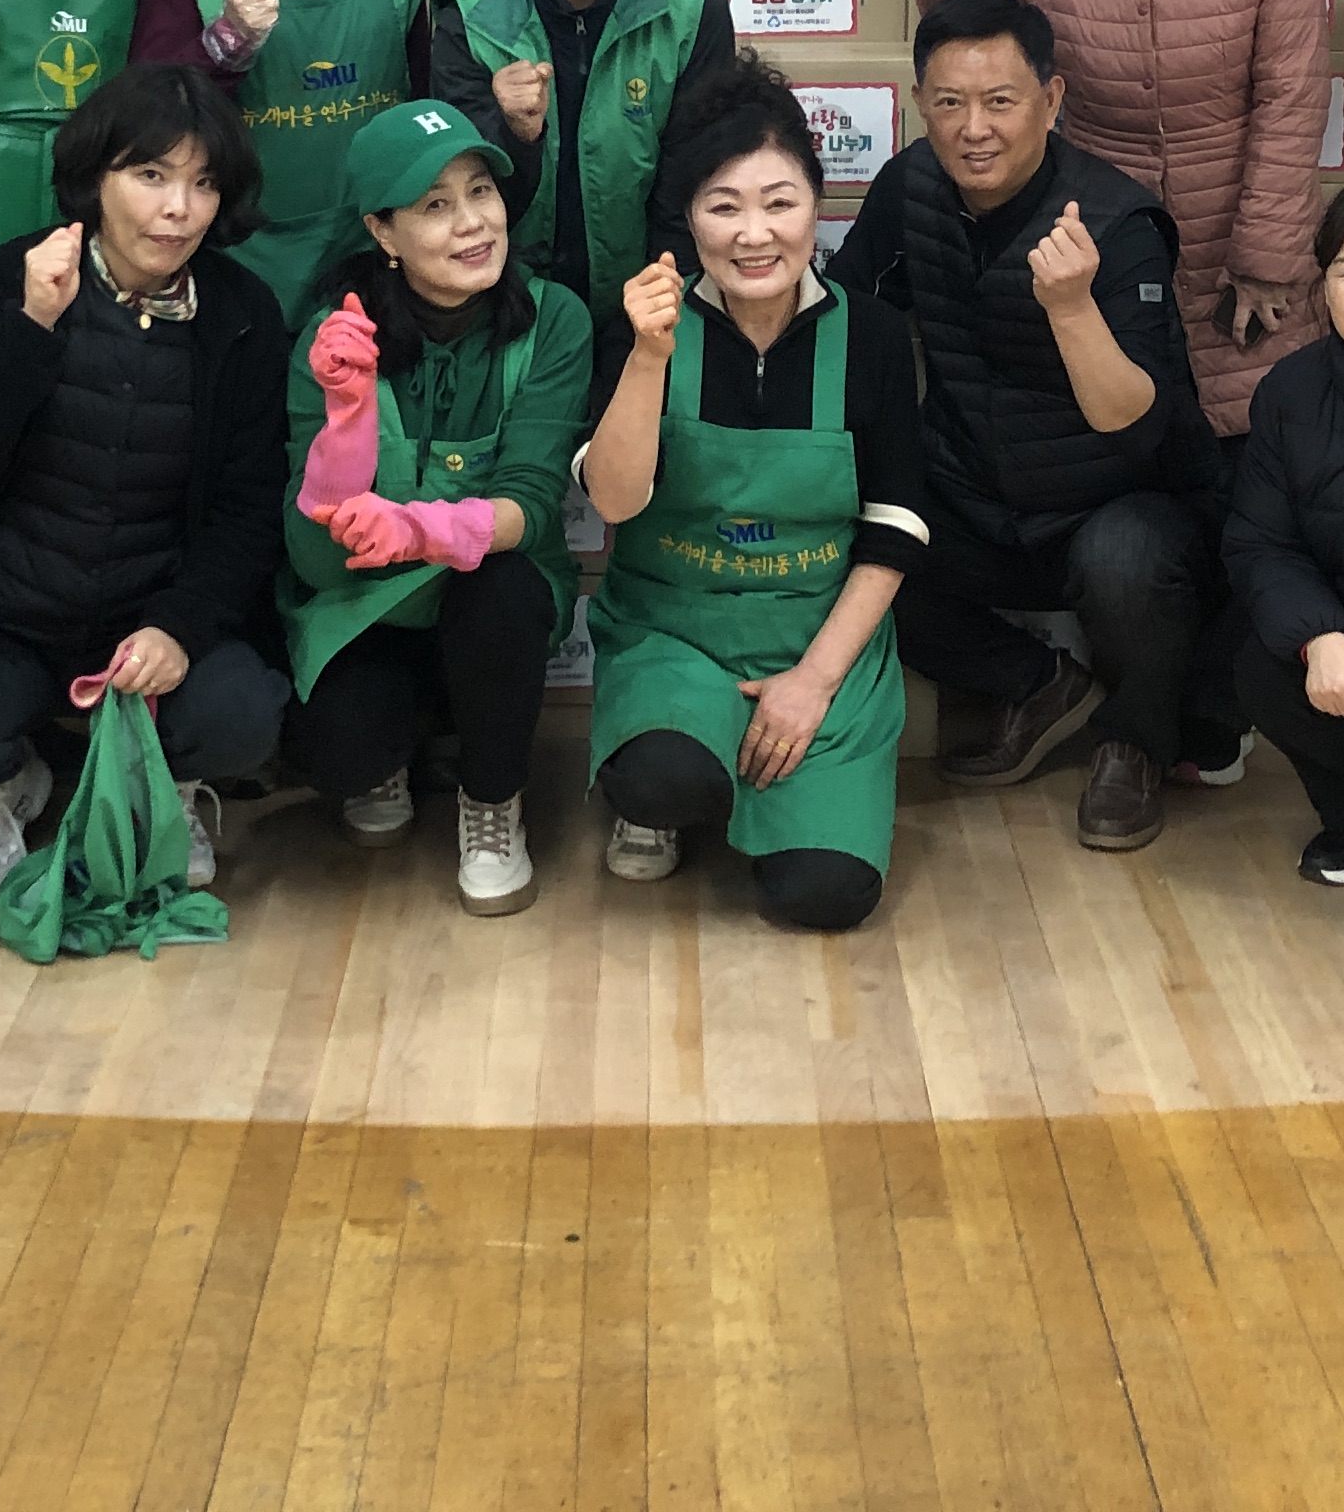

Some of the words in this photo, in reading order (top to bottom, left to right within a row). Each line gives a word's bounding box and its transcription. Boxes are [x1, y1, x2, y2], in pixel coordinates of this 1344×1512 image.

[51, 11, 87, 33] SMU
[303, 62, 358, 91] SMU
[413, 111, 452, 135] H
[828, 134, 872, 152] 나누기
[717, 518, 776, 544] SMU
